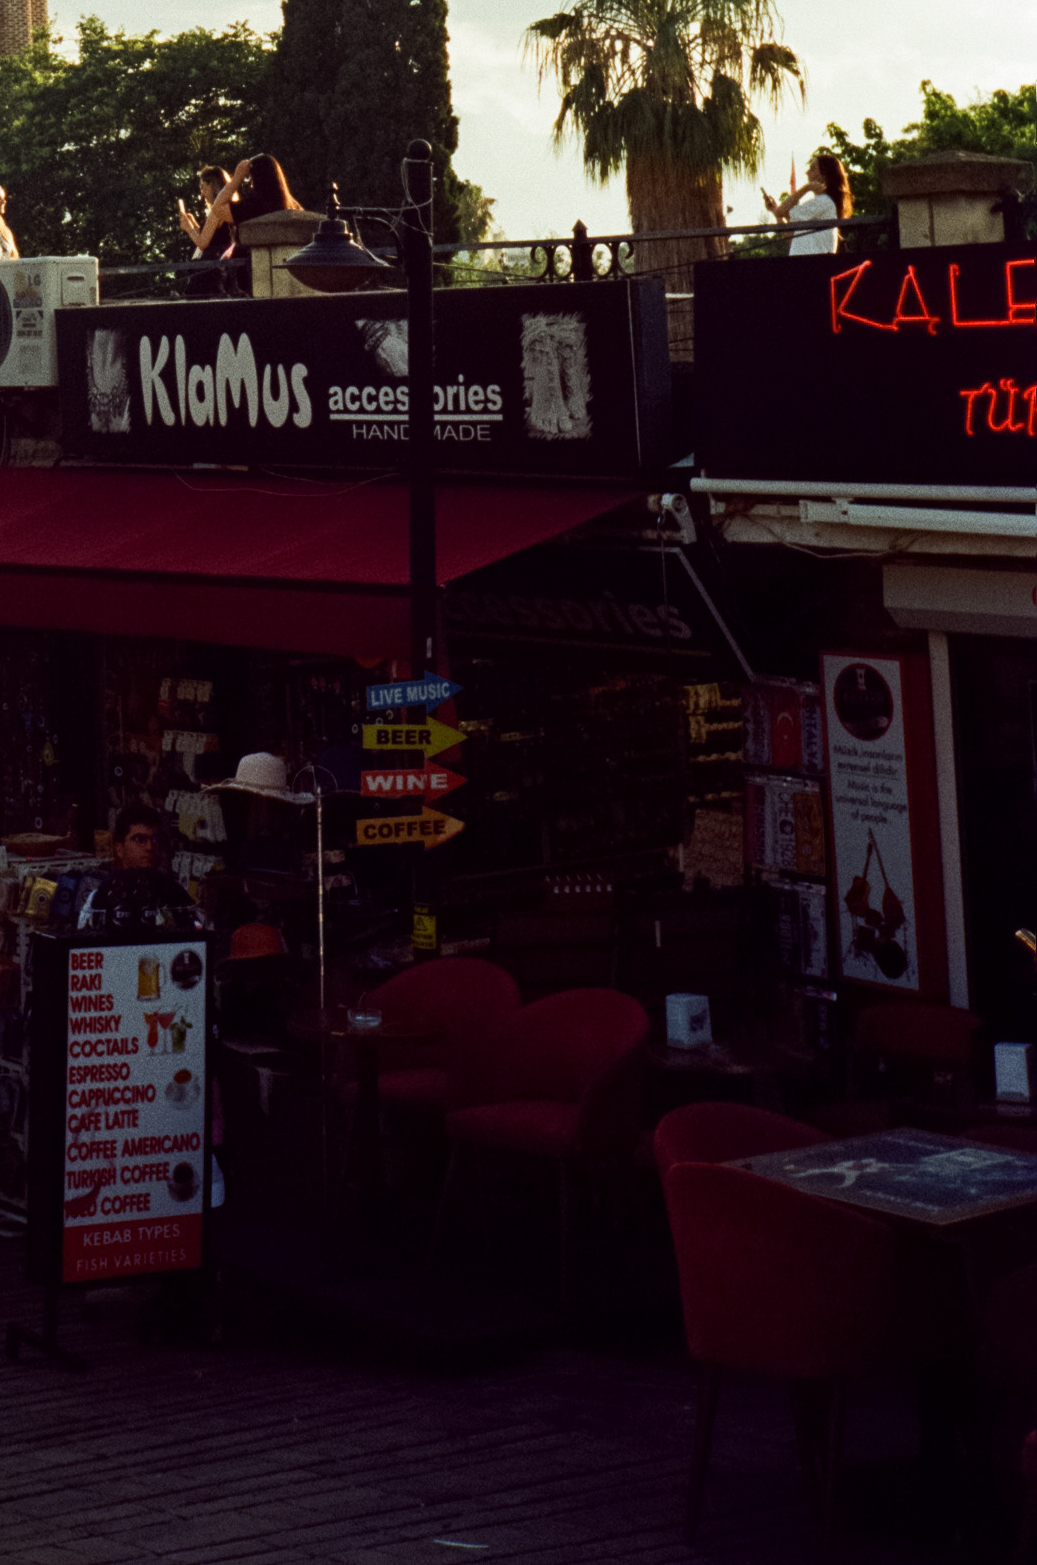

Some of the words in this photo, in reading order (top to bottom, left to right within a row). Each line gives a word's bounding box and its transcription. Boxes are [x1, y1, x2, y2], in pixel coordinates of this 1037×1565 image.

[328, 373, 504, 412] accesories
[441, 588, 694, 641] ccessories
[370, 687, 404, 707] LIVE
[406, 681, 451, 703] MUSIC
[376, 729, 432, 746] BEER
[365, 772, 449, 792] WINE
[363, 819, 447, 840] COFFEE
[71, 951, 104, 970] BEER
[71, 973, 103, 991] RAKI
[70, 994, 114, 1013] WINES
[70, 1014, 122, 1034] WHISKY
[69, 1037, 139, 1058] COCTAILS
[69, 1063, 131, 1084] ESPRESSO
[68, 1084, 157, 1108] CAPPUCCINO
[68, 1113, 101, 1134] CAFE
[105, 1109, 139, 1130] LATTE
[67, 1140, 118, 1162] COFFEE
[121, 1132, 201, 1157] AMERICANO
[66, 1167, 117, 1189] TURKISH
[120, 1162, 171, 1185] COFFEE
[100, 1192, 151, 1216] COFFEE
[82, 1227, 132, 1247] KEBAB
[137, 1223, 181, 1241] TYPES
[76, 1257, 108, 1273] FISH
[113, 1248, 187, 1268] VARIETIES
